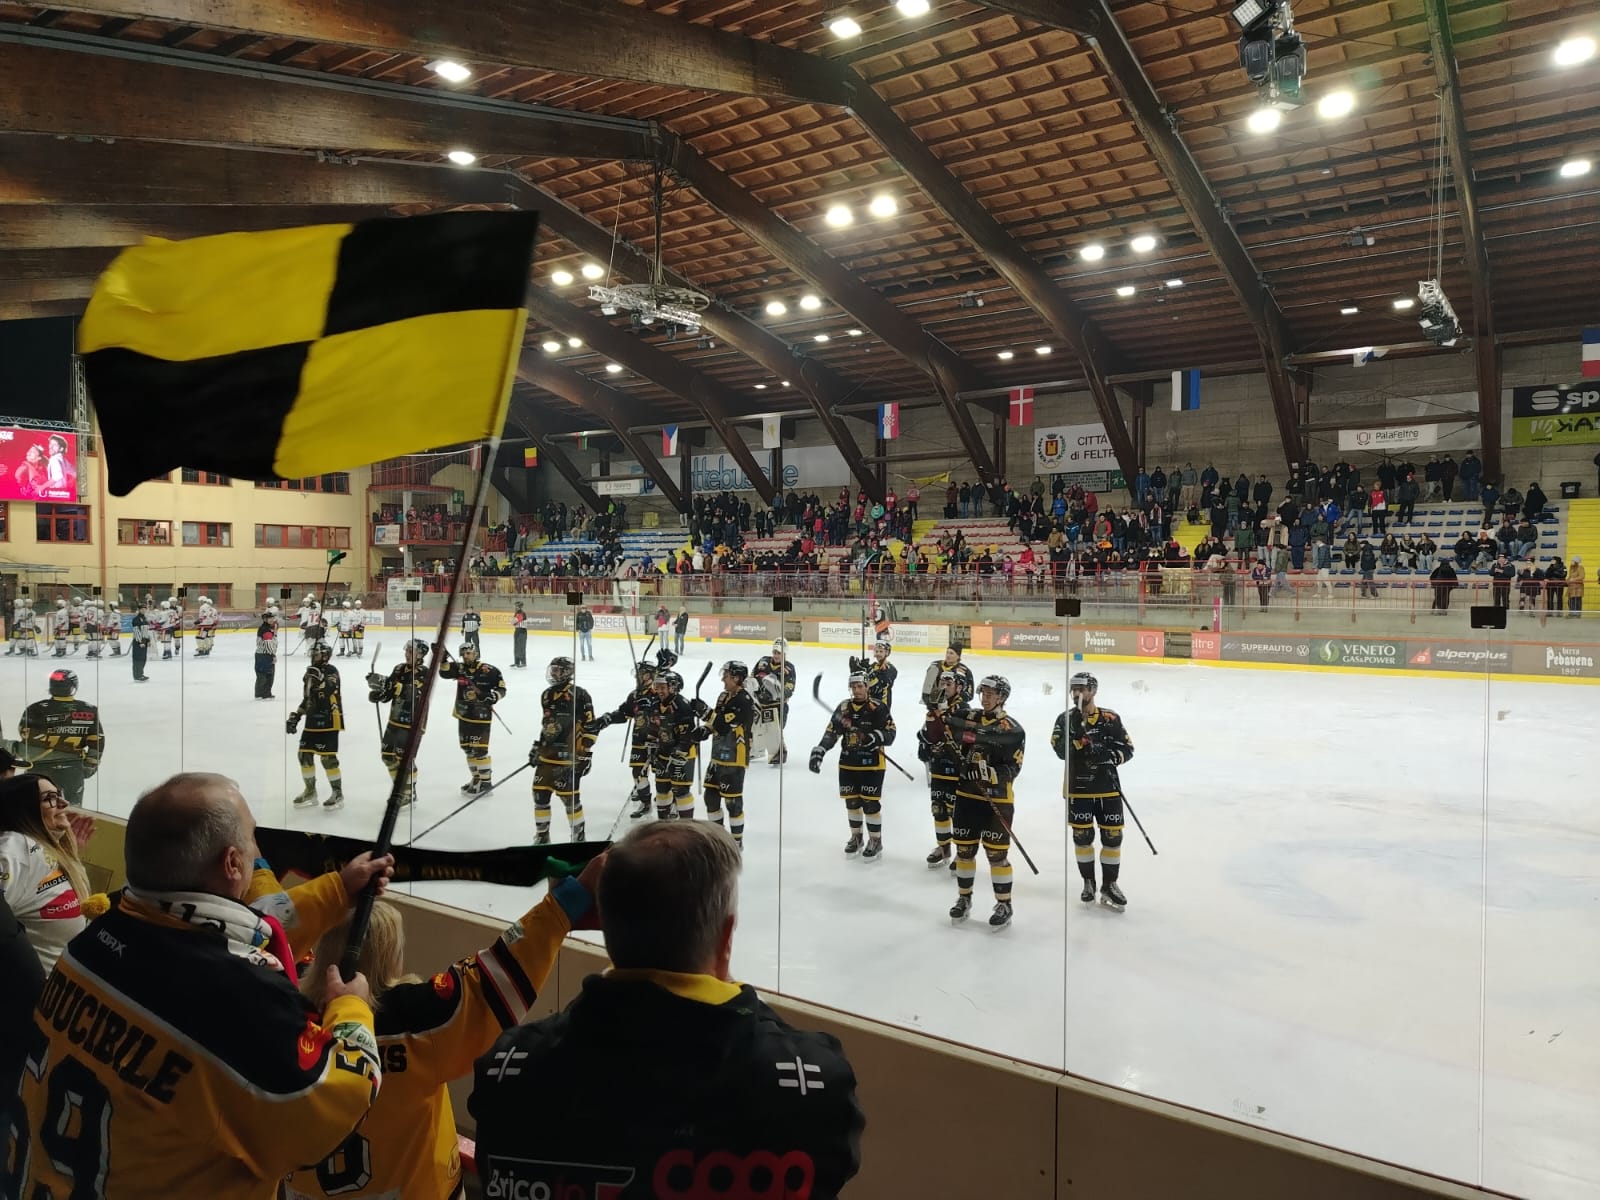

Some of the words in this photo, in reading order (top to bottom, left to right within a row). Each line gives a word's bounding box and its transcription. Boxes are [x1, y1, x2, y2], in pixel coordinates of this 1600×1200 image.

[1375, 430, 1419, 440] PalaFeltre
[1071, 451, 1080, 461] di
[1084, 449, 1117, 459] FELTR
[1013, 632, 1061, 644] alpenplus
[1241, 643, 1293, 653] SUPERAUTO
[1343, 644, 1396, 656] VENETO
[1342, 655, 1396, 665] GAS&POWER
[1436, 648, 1508, 661] alpenplus
